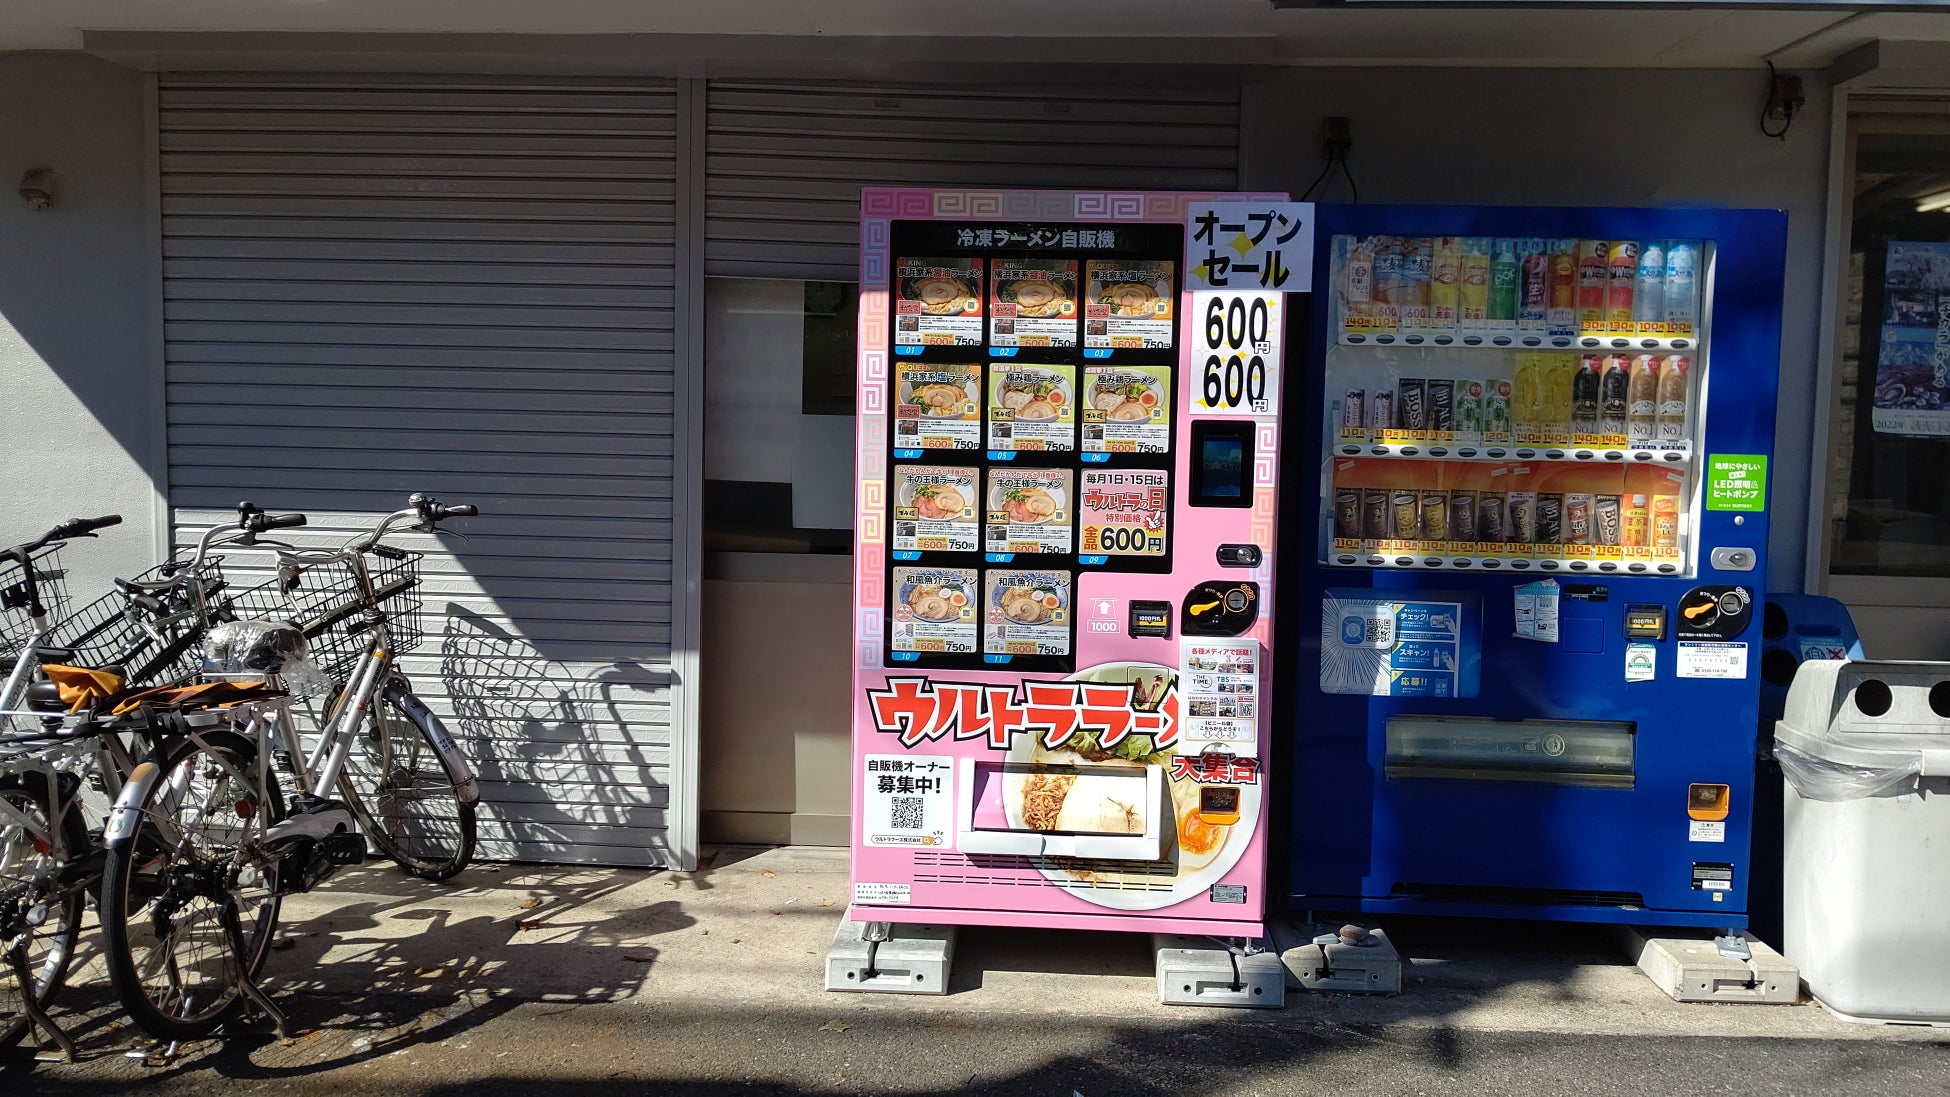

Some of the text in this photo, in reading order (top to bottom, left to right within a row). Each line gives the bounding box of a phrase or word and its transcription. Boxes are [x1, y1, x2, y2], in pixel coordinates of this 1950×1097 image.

[1193, 209, 1302, 246] オープン
[956, 228, 1116, 249] 冷凍ラーメン自販機
[1203, 249, 1290, 288] セール
[1206, 297, 1270, 354] 600円
[999, 348, 1009, 356] 02
[1094, 349, 1104, 357] 03
[901, 371, 980, 382] 横浜家系塩ラーメン
[1006, 373, 1065, 384] 極み鶏ラーメン
[1098, 375, 1158, 385] 極み鶏ラーメン
[1204, 355, 1268, 412] 600円
[1407, 390, 1421, 429] BOSS
[1715, 462, 1760, 470] 地球にやさしい
[907, 475, 971, 486] 牛の王様ラーメン
[997, 479, 1063, 489] 牛の王様ラーメン
[1087, 474, 1163, 485] 毎月1日・15日は
[1083, 487, 1166, 511] ウルトラの日
[1713, 490, 1758, 499] ヒートポンプ
[1105, 513, 1141, 523] 特別価格
[1605, 508, 1618, 545] BOSS
[1084, 526, 1098, 551] 全品
[1100, 527, 1163, 552] 600円
[948, 541, 974, 550] 750円
[906, 575, 977, 586] 和風魚介ラーメン
[999, 577, 1071, 588] 和風魚介ラーメン
[1400, 613, 1429, 621] チェック!
[1092, 622, 1117, 632] 1000
[946, 643, 972, 652] 750円
[1038, 645, 1064, 655] 750円
[1192, 647, 1252, 656] 各種メディアで話題!
[1399, 649, 1430, 657] スキャン!
[868, 759, 950, 773] 自販機オーナー
[1170, 753, 1262, 785] 大集合
[877, 775, 941, 795] 募集中!
